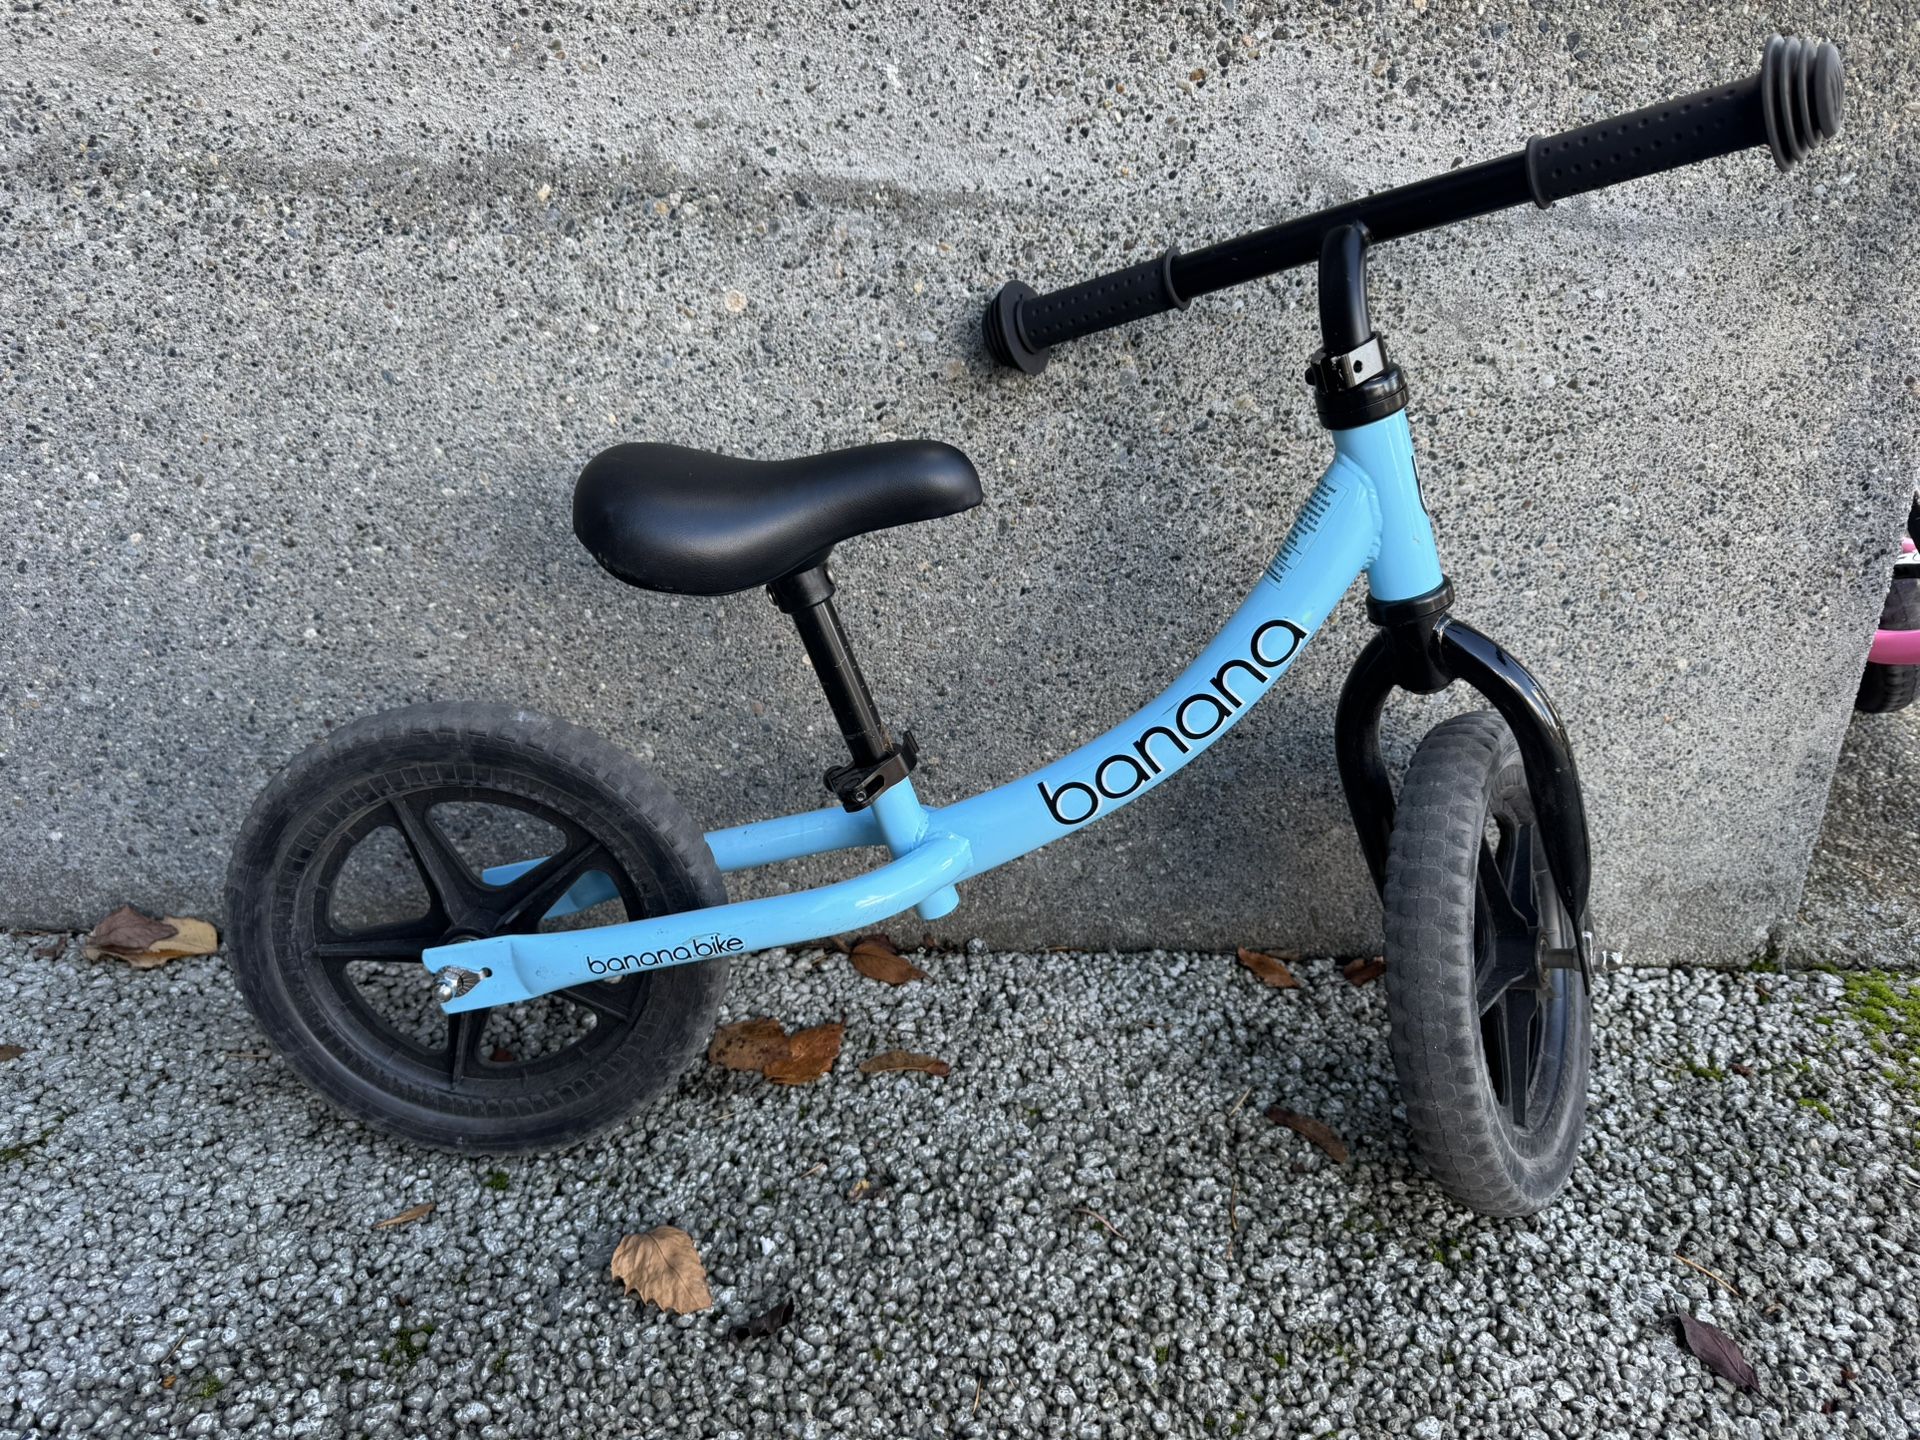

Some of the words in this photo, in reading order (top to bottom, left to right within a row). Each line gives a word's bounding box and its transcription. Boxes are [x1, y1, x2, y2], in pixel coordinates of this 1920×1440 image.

[1037, 619, 1308, 825] banana
[587, 946, 692, 974] banana
[693, 935, 744, 957] bike
